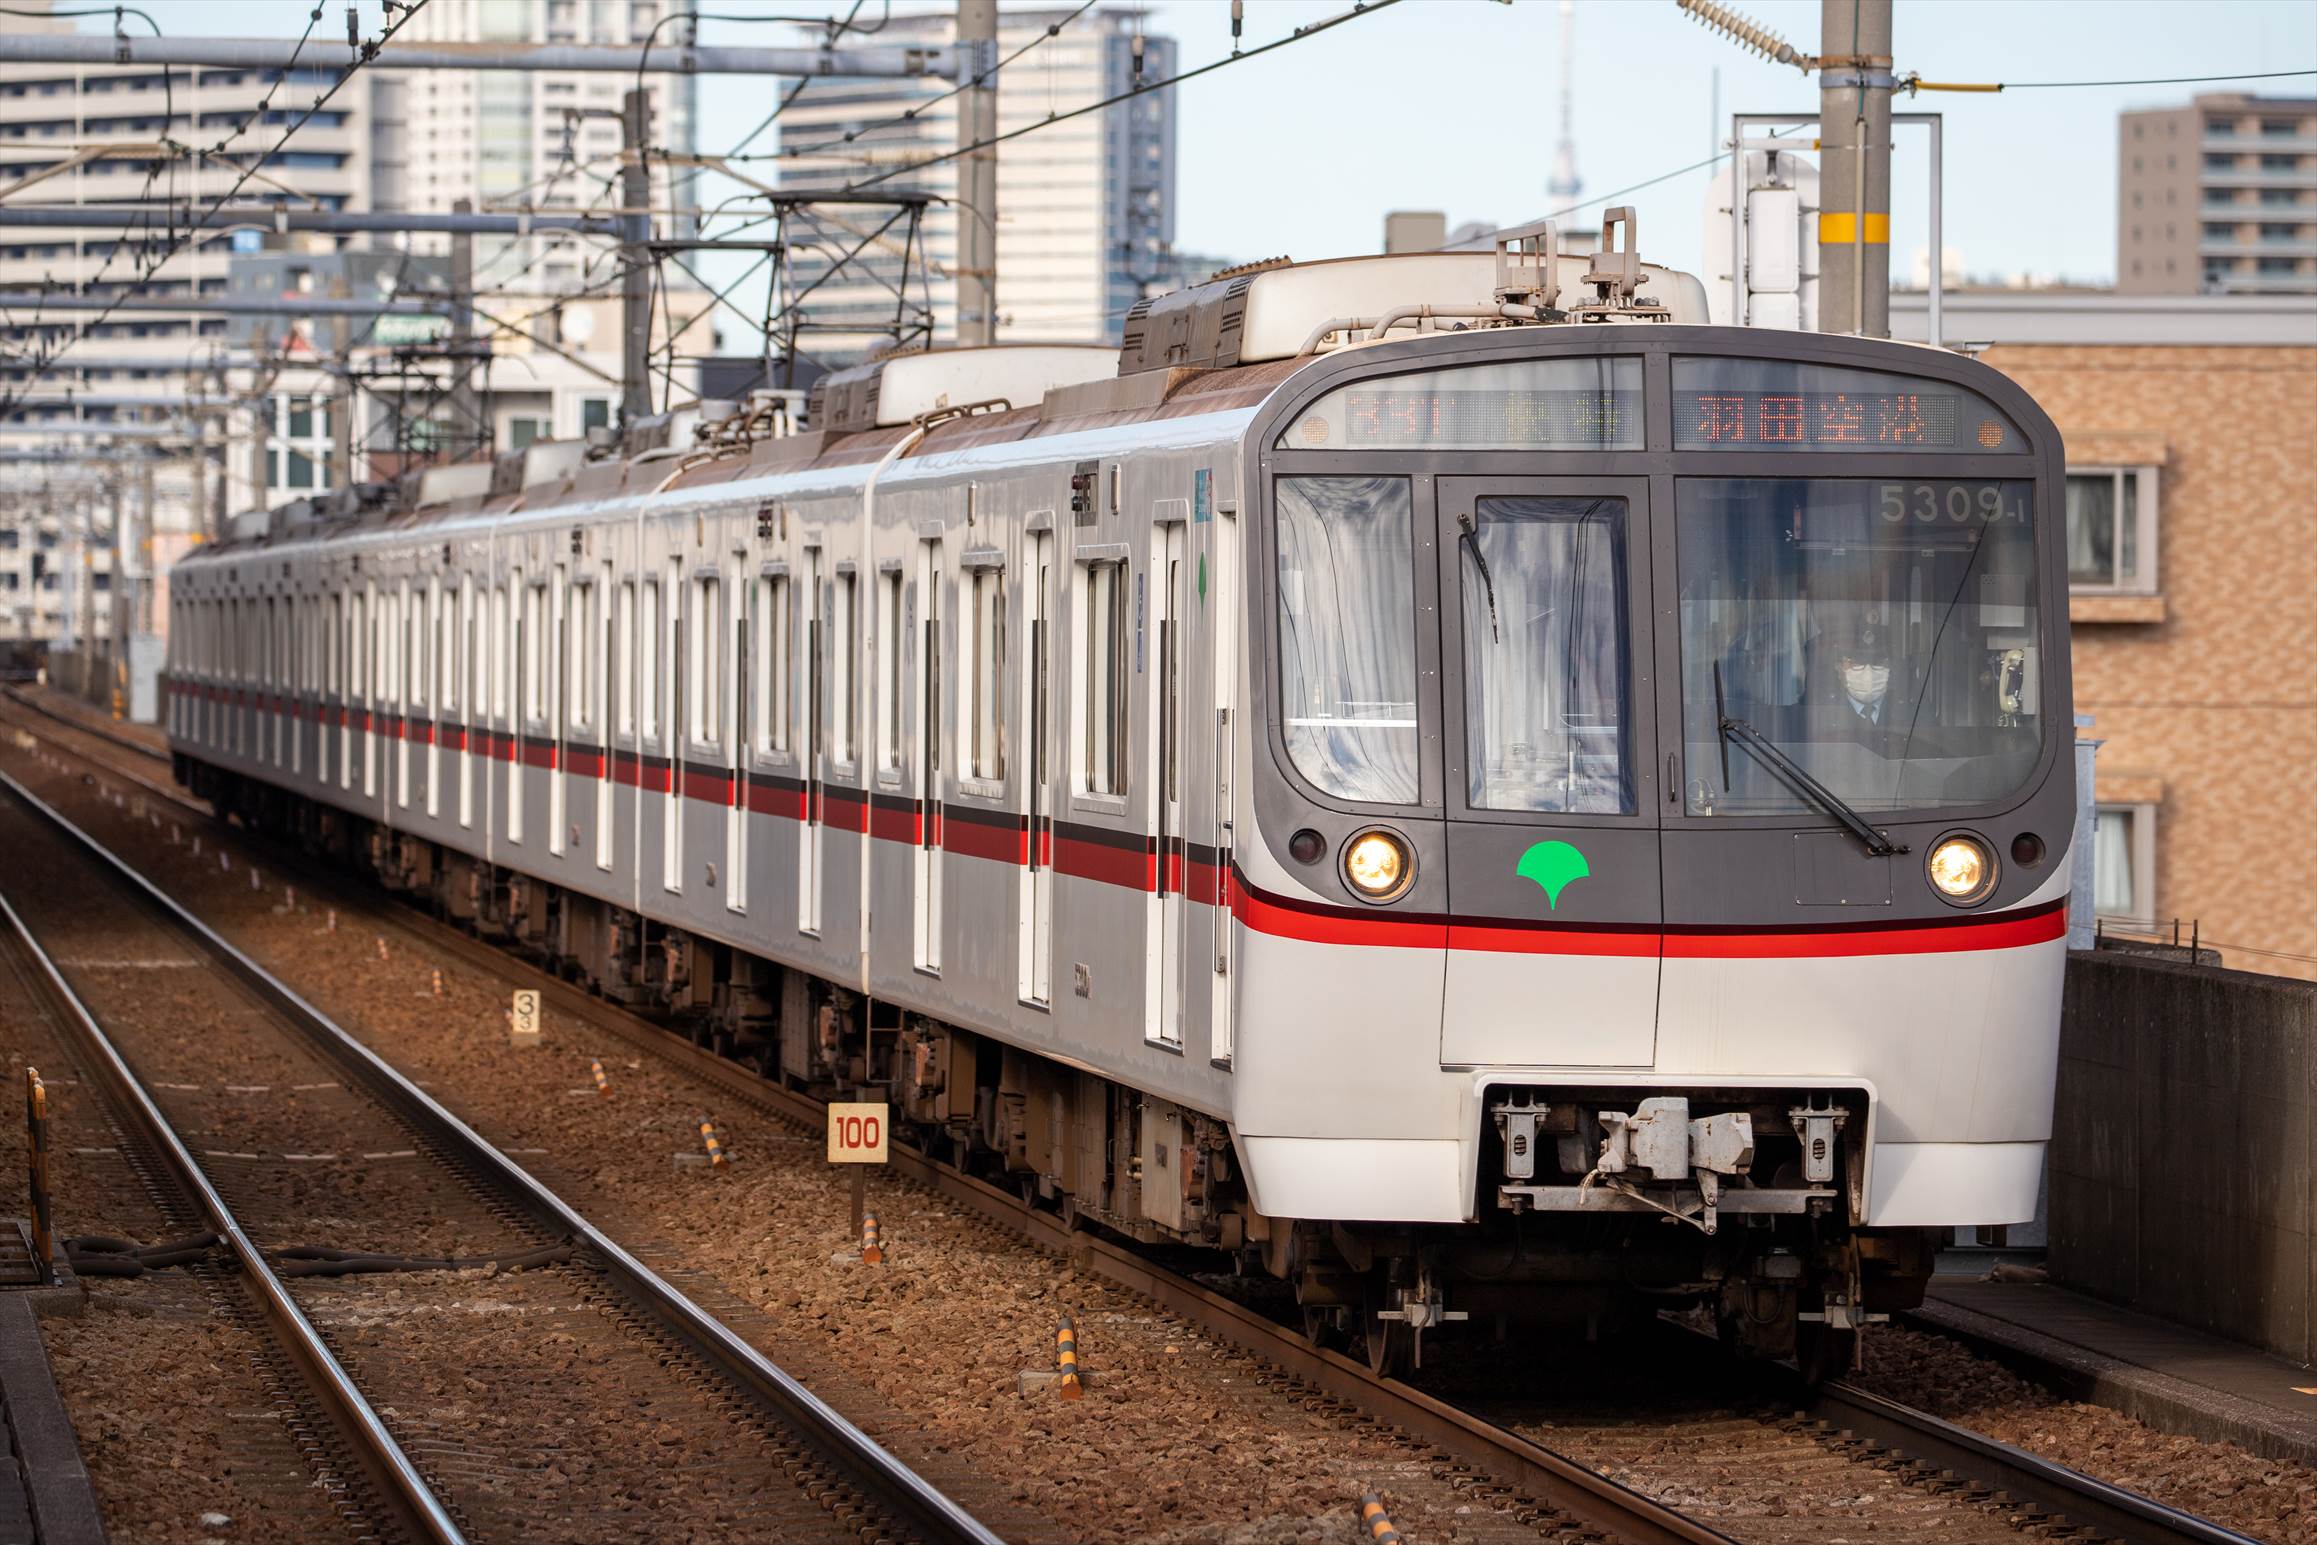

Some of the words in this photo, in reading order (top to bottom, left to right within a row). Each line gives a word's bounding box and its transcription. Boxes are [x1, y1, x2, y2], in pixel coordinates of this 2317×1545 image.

[1696, 395, 1926, 442] 羽田空港
[1880, 486, 2025, 523] 5309-1
[518, 993, 534, 1015] 3
[836, 1116, 880, 1149] 100
